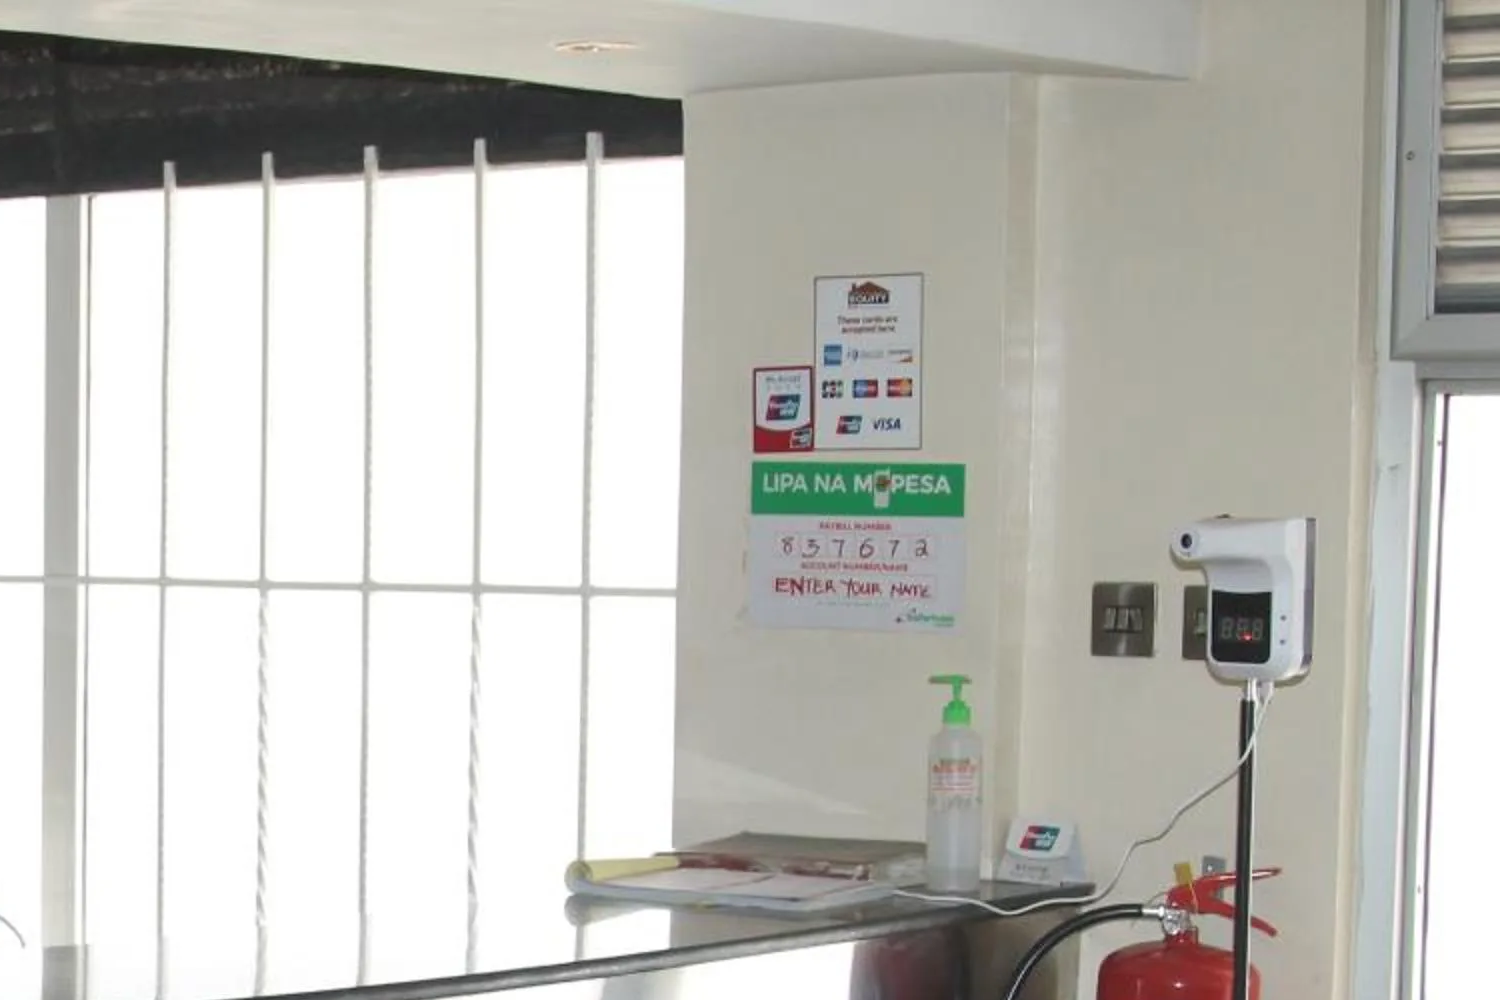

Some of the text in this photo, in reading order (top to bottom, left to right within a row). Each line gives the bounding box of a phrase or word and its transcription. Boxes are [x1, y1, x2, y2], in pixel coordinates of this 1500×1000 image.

[873, 418, 901, 431] VISA
[762, 472, 808, 494] LIPA
[814, 473, 847, 494] NA
[774, 575, 837, 597] ENTER
[840, 577, 883, 599] YOUR
